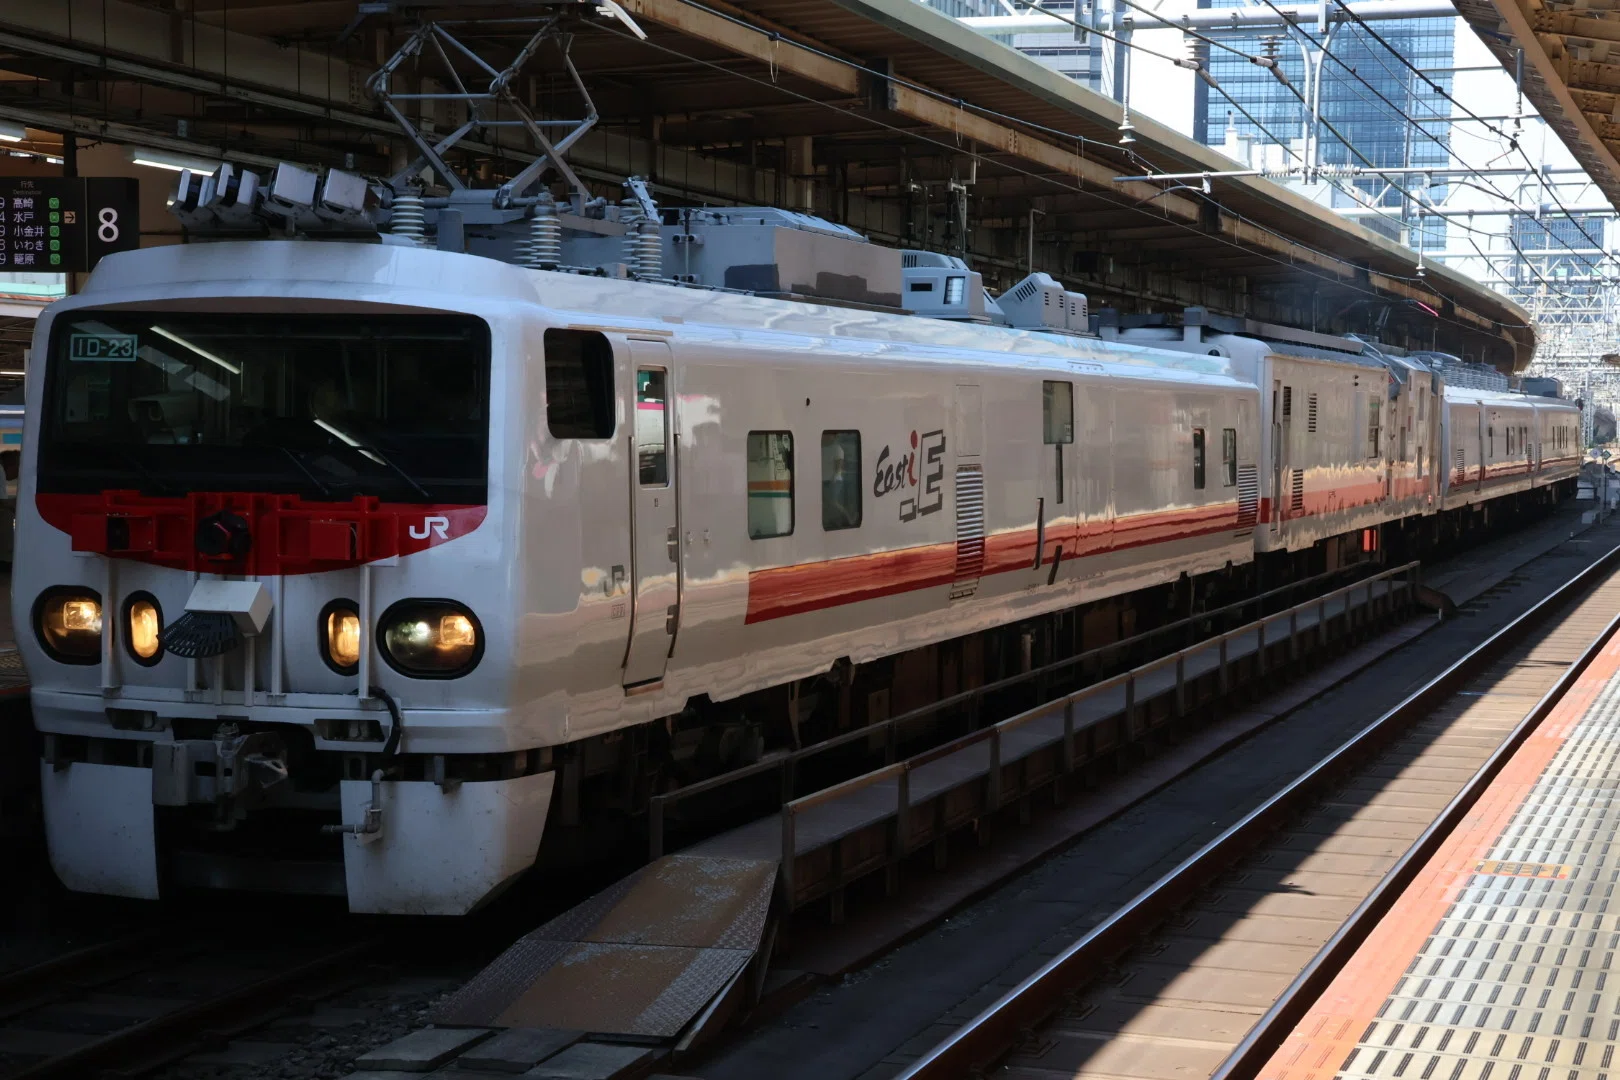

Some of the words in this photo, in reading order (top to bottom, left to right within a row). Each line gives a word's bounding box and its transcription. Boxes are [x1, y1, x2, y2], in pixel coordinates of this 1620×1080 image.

[13, 211, 34, 223] 水戸
[97, 207, 120, 243] 8
[13, 225, 45, 237] 小金井
[14, 239, 45, 251] いわき
[77, 338, 133, 357] ID-23
[408, 516, 450, 540] JR
[603, 564, 626, 598] JR
